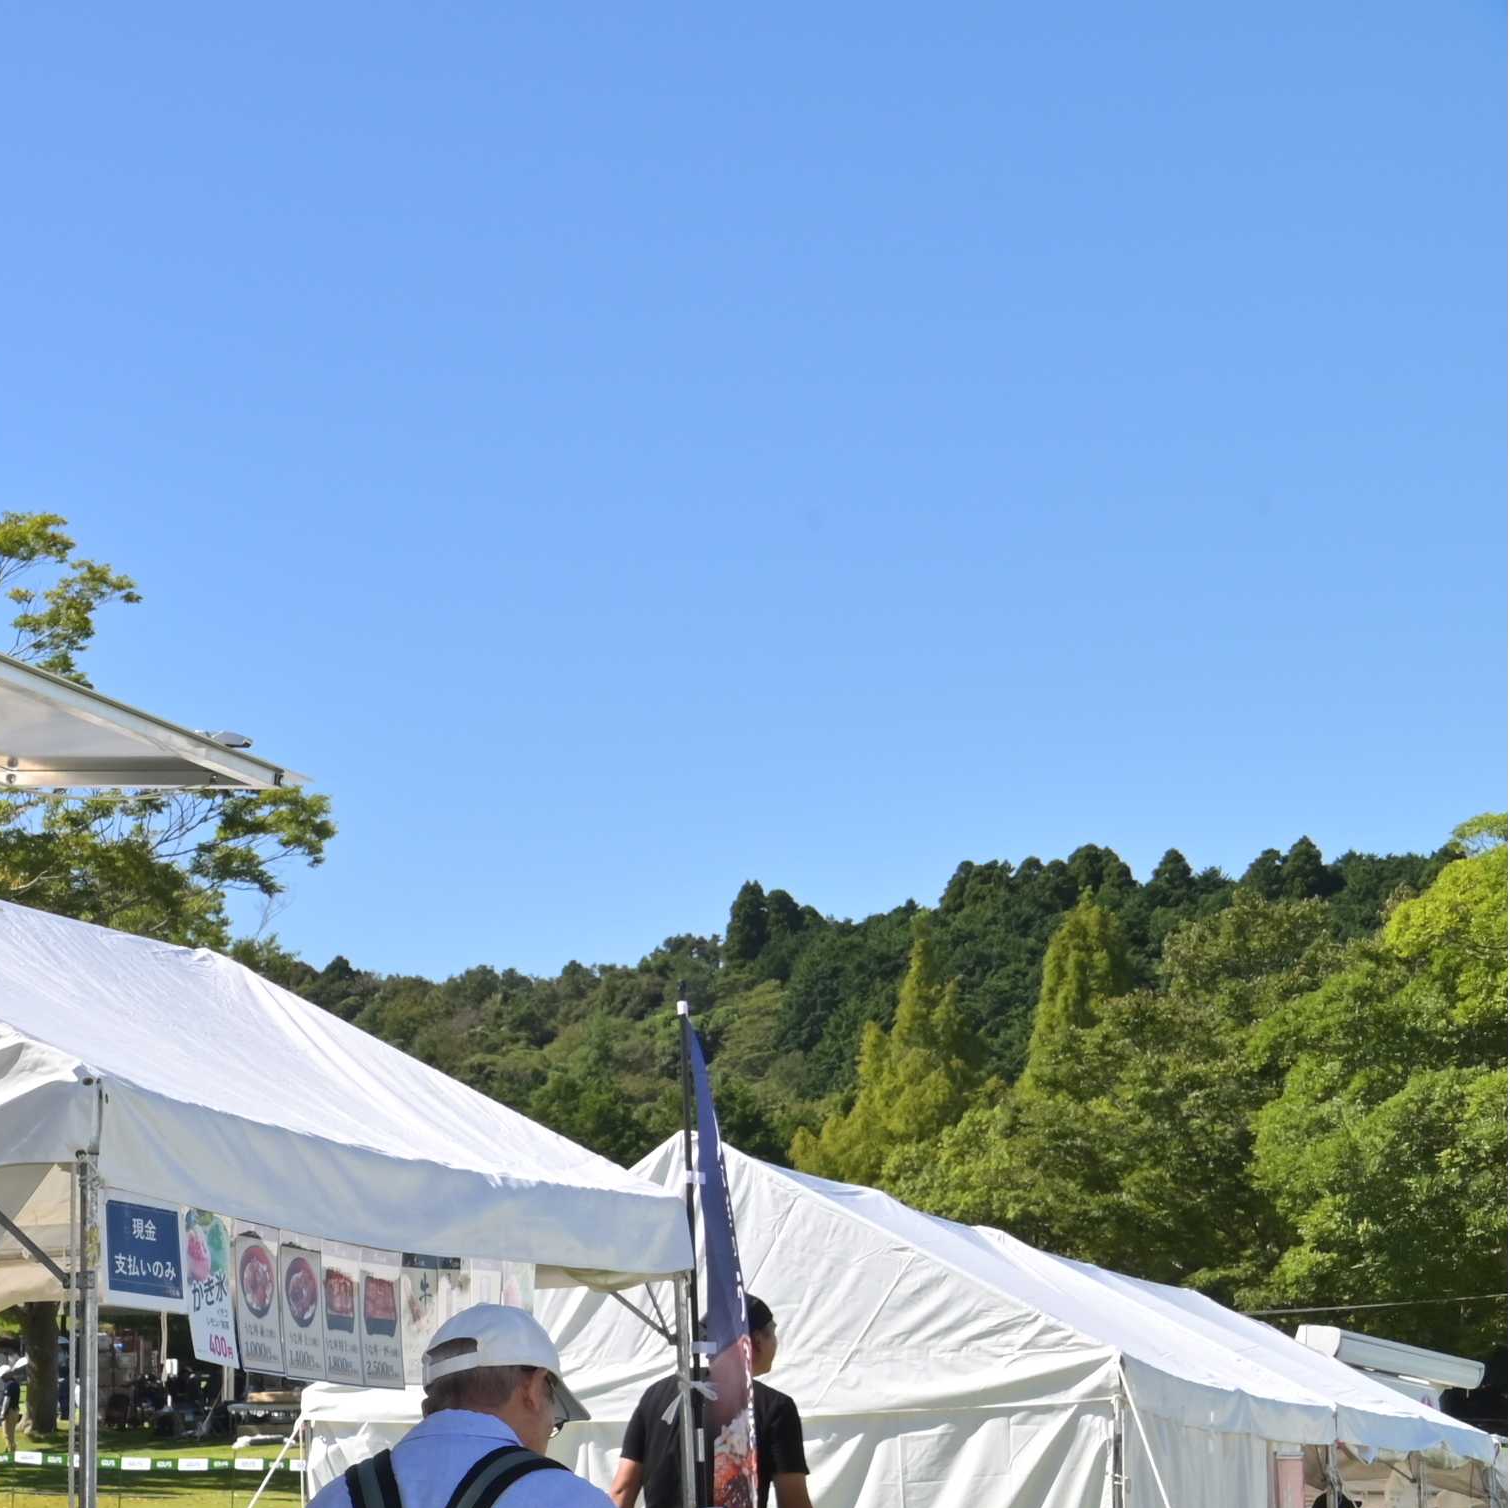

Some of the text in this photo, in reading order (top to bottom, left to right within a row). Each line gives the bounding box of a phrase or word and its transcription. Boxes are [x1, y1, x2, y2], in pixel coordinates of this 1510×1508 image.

[131, 1218, 157, 1241] 現金
[114, 1253, 177, 1281] 支払いのみ
[191, 1271, 228, 1312] かき氷
